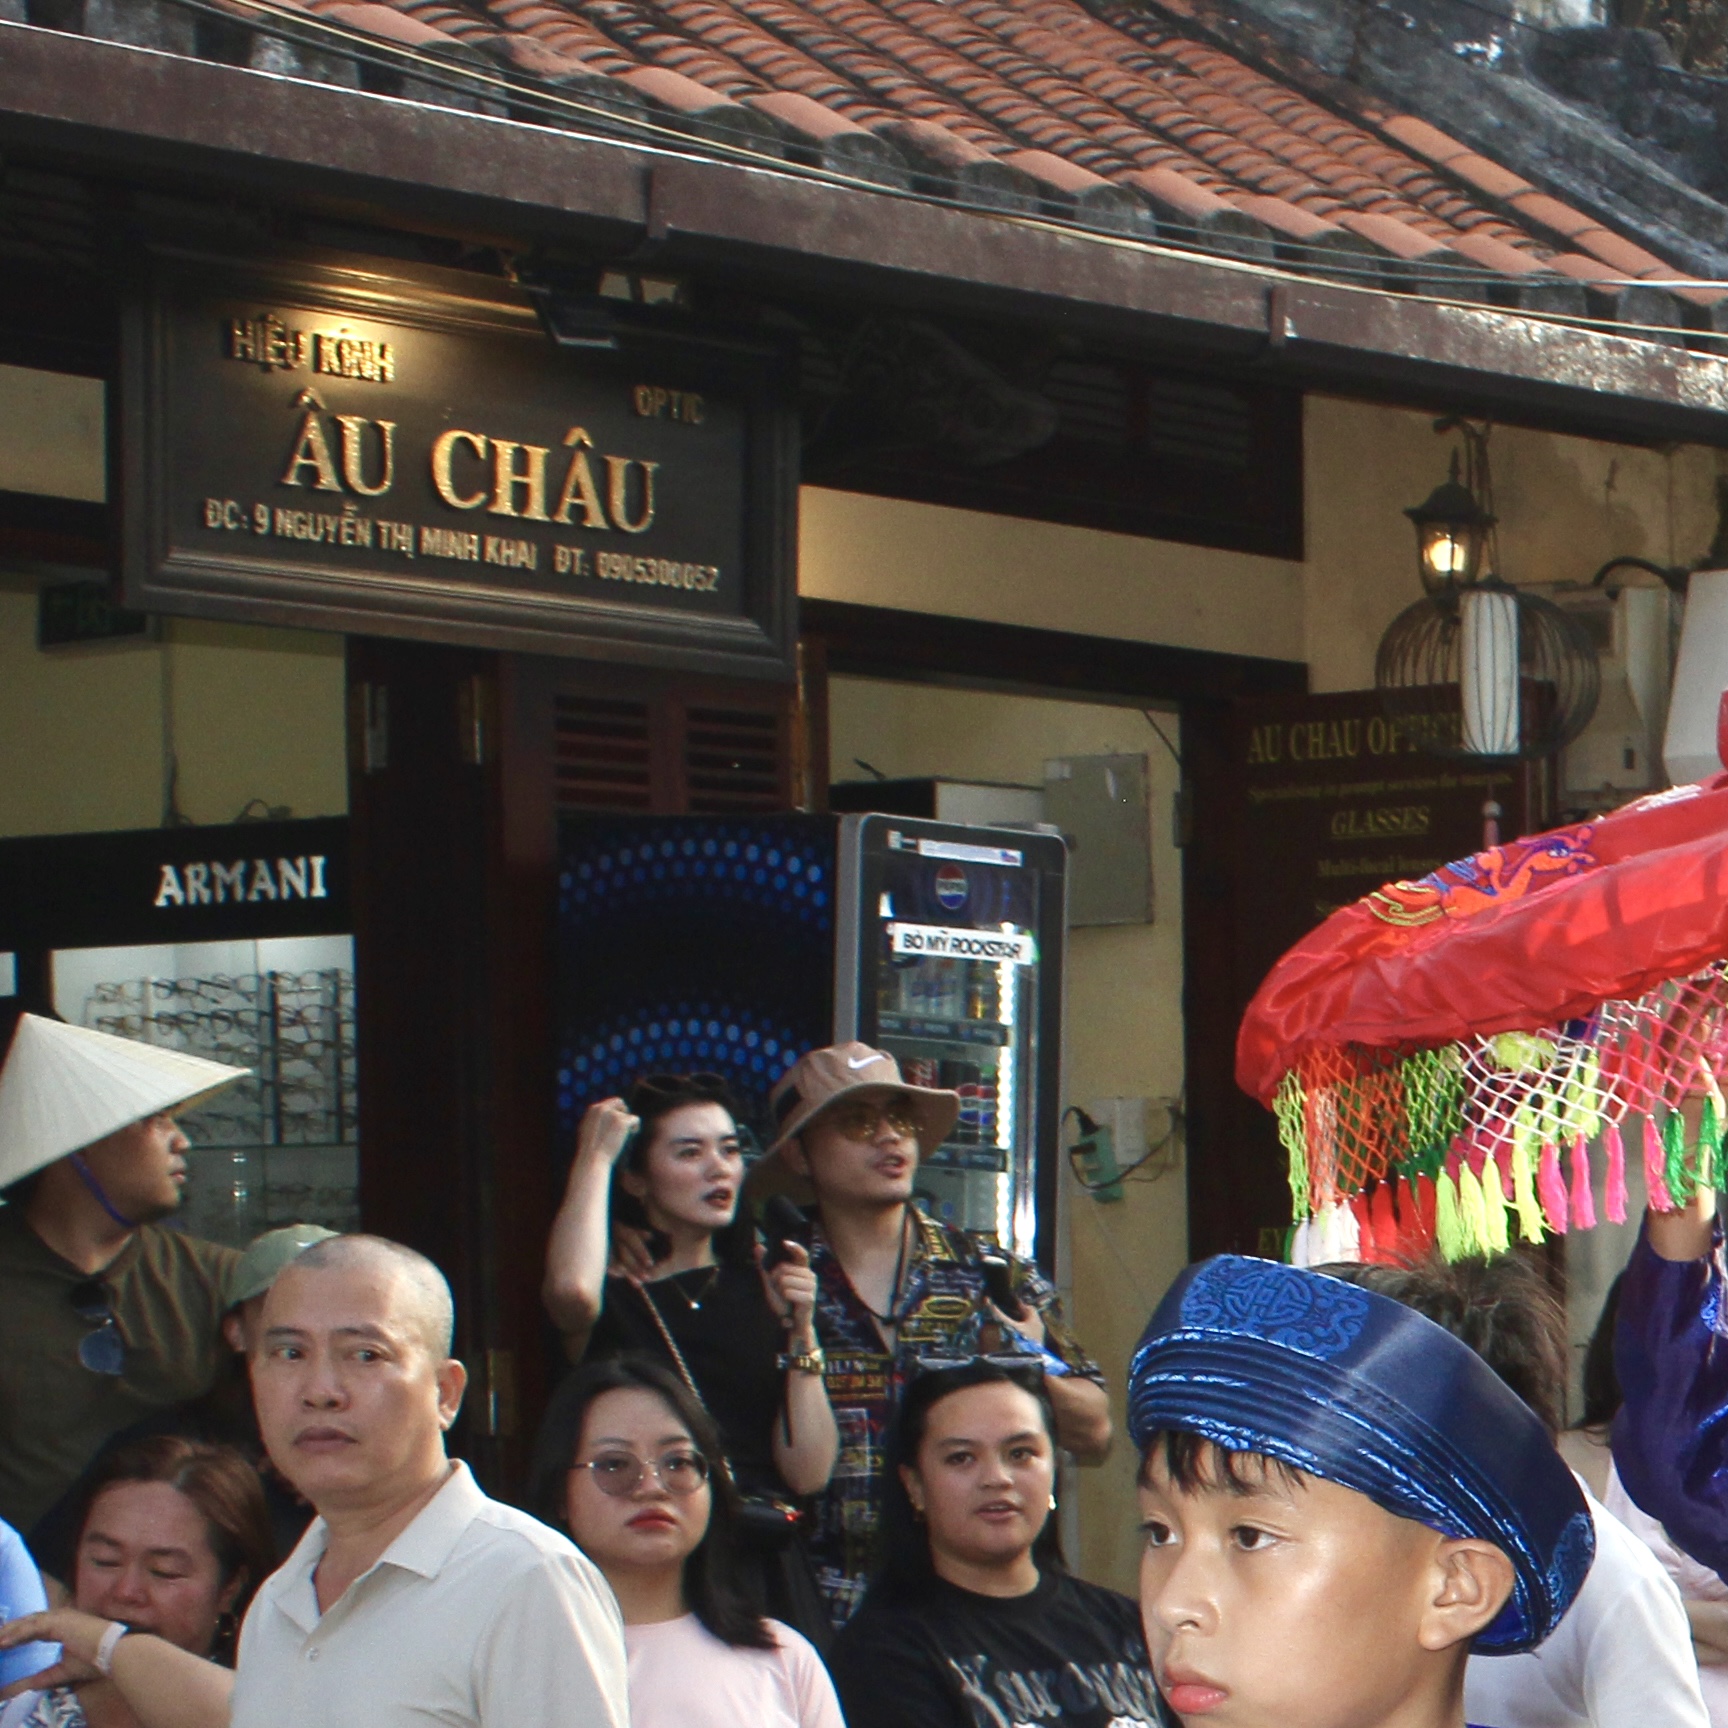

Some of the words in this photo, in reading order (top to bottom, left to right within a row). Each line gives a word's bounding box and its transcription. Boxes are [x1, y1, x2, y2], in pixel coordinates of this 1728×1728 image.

[633, 384, 704, 424] OPTIC
[279, 386, 398, 497] ÂU
[431, 426, 661, 533] CHÂU
[253, 502, 270, 535] 9
[419, 526, 479, 561] MINH
[484, 534, 538, 570] KHAI
[1249, 723, 1283, 764] AU
[1289, 718, 1361, 761] CHAU
[1330, 805, 1431, 835] GLASSES
[154, 855, 329, 907] ARMANI
